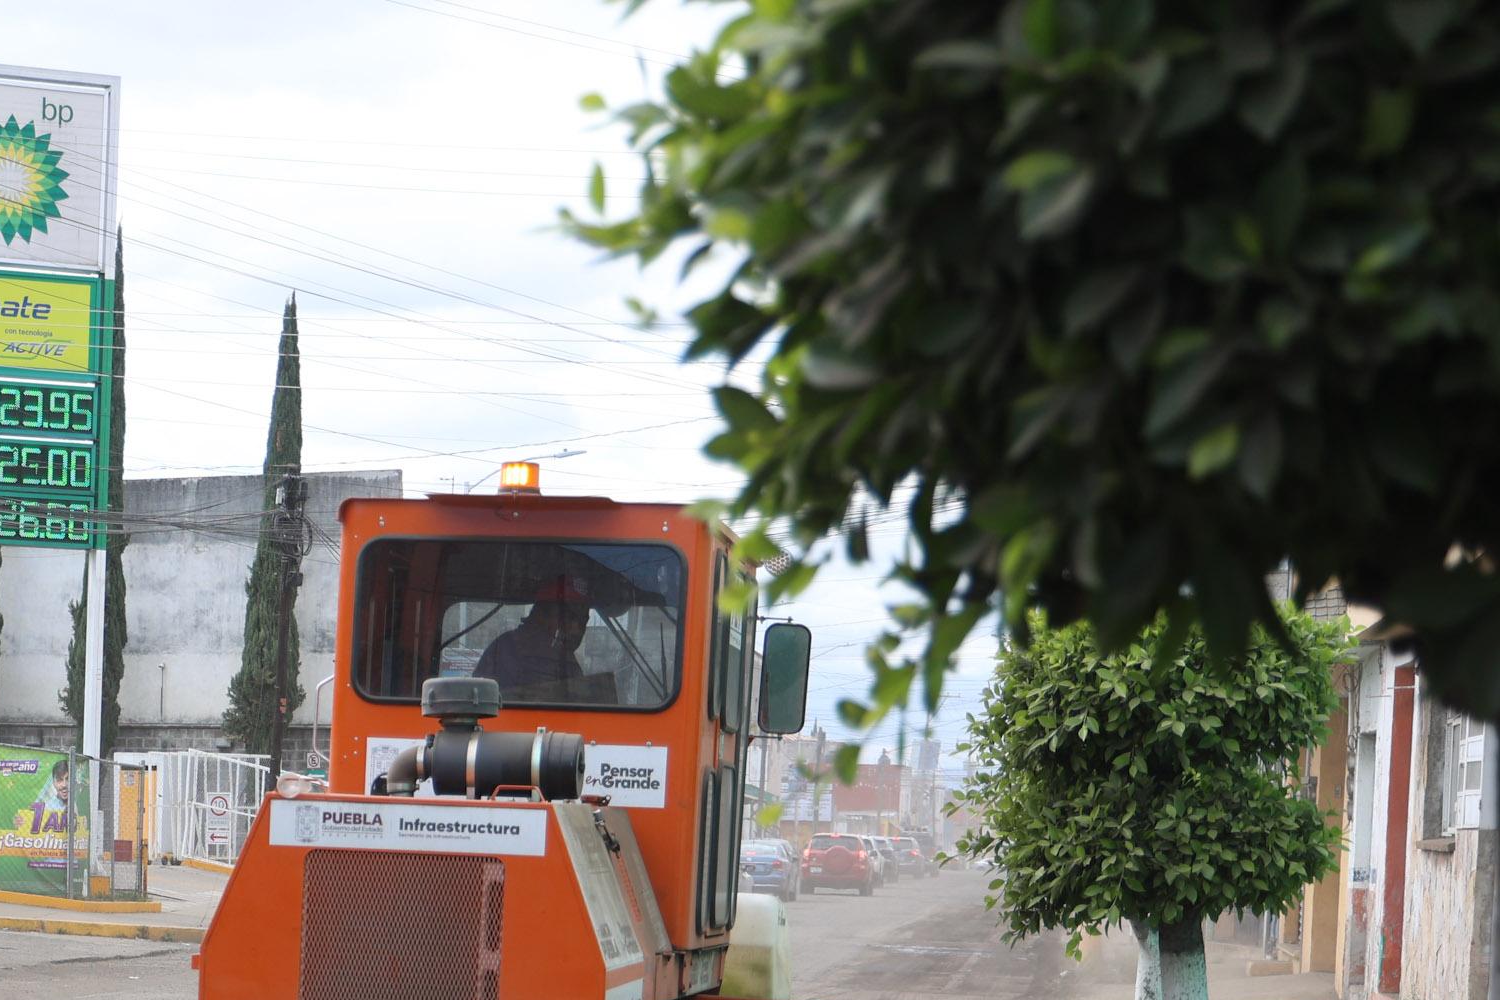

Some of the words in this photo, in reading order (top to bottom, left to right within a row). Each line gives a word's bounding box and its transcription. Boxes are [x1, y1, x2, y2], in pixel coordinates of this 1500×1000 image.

[41, 96, 74, 128] bp
[3, 341, 68, 357] ACTIVE
[0, 387, 92, 431] 23.95
[19, 761, 36, 771] año
[600, 763, 654, 778] Pensar
[585, 775, 602, 787] en
[602, 775, 660, 790] Grande
[30, 802, 45, 834] 1
[322, 811, 383, 826] PUEBLA
[399, 817, 520, 836] Infraestructura
